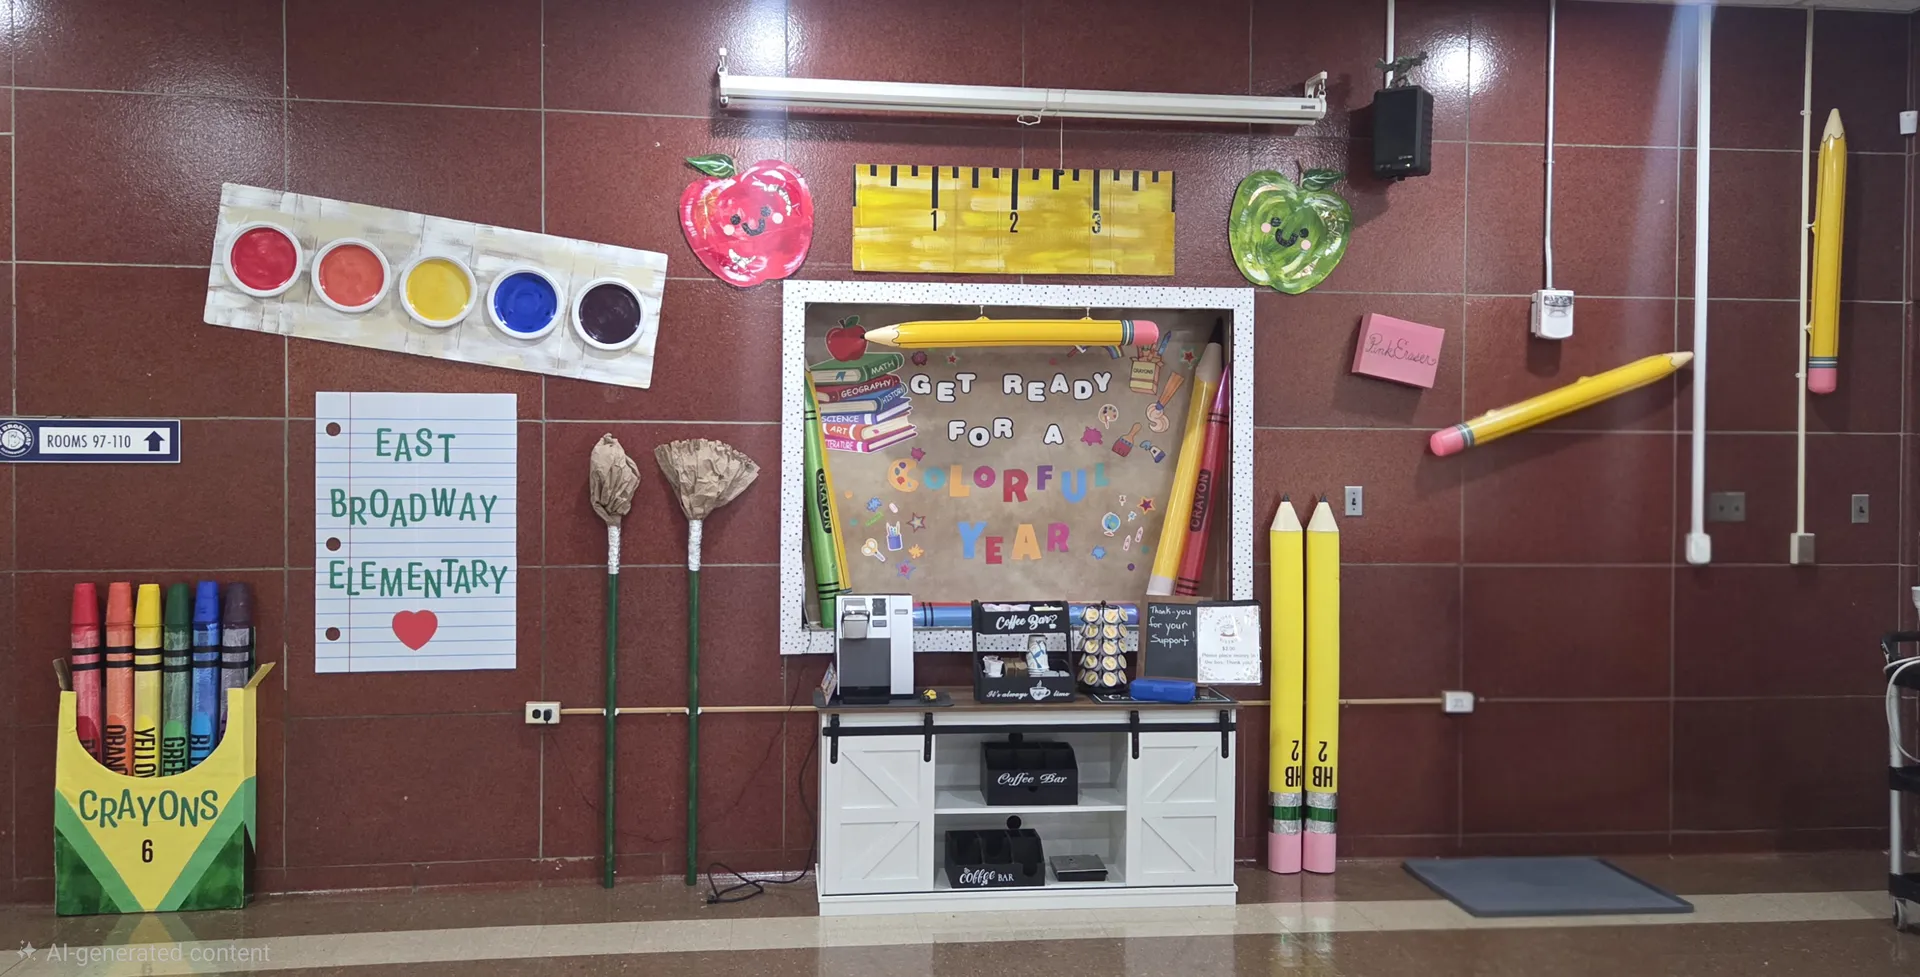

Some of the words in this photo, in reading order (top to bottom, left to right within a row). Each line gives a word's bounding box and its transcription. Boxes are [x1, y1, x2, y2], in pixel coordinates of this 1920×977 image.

[930, 210, 938, 231] 1
[1009, 211, 1018, 233] 2
[1091, 212, 1102, 234] 3
[871, 361, 895, 376] MATH
[841, 379, 892, 398] GEOGRAPHY
[881, 387, 904, 404] HISTORY
[910, 372, 977, 402] GET
[1003, 371, 1112, 402] READY
[821, 415, 859, 423] SCIENCE
[830, 425, 848, 435] ART
[947, 416, 1014, 447] FOR
[1043, 423, 1064, 445] A
[47, 435, 88, 448] ROOMS
[92, 435, 131, 448] 97-110
[376, 427, 456, 463] EAST
[825, 439, 854, 450] TERATURE
[888, 458, 1110, 504] COLORFUL
[330, 487, 498, 527] BROADWAY
[818, 473, 831, 529] CRAYON
[1191, 473, 1209, 528] CRAYON
[957, 521, 1070, 564] YEAR
[329, 558, 508, 598] ELEMENTARY
[996, 614, 1026, 630] Coffee
[1028, 614, 1050, 630] Bar
[1148, 616, 1163, 629] for
[1165, 622, 1188, 636] your
[1001, 690, 1028, 699] always
[163, 736, 186, 775] GREE
[1291, 740, 1299, 761] 2
[1318, 741, 1328, 762] 2
[997, 772, 1034, 786] Coffee
[1040, 772, 1067, 784] Bar
[1285, 766, 1302, 787] HB
[1312, 766, 1333, 787] HB
[79, 788, 218, 828] CRAYONS
[142, 839, 153, 863] 6
[997, 873, 1015, 882] BAR
